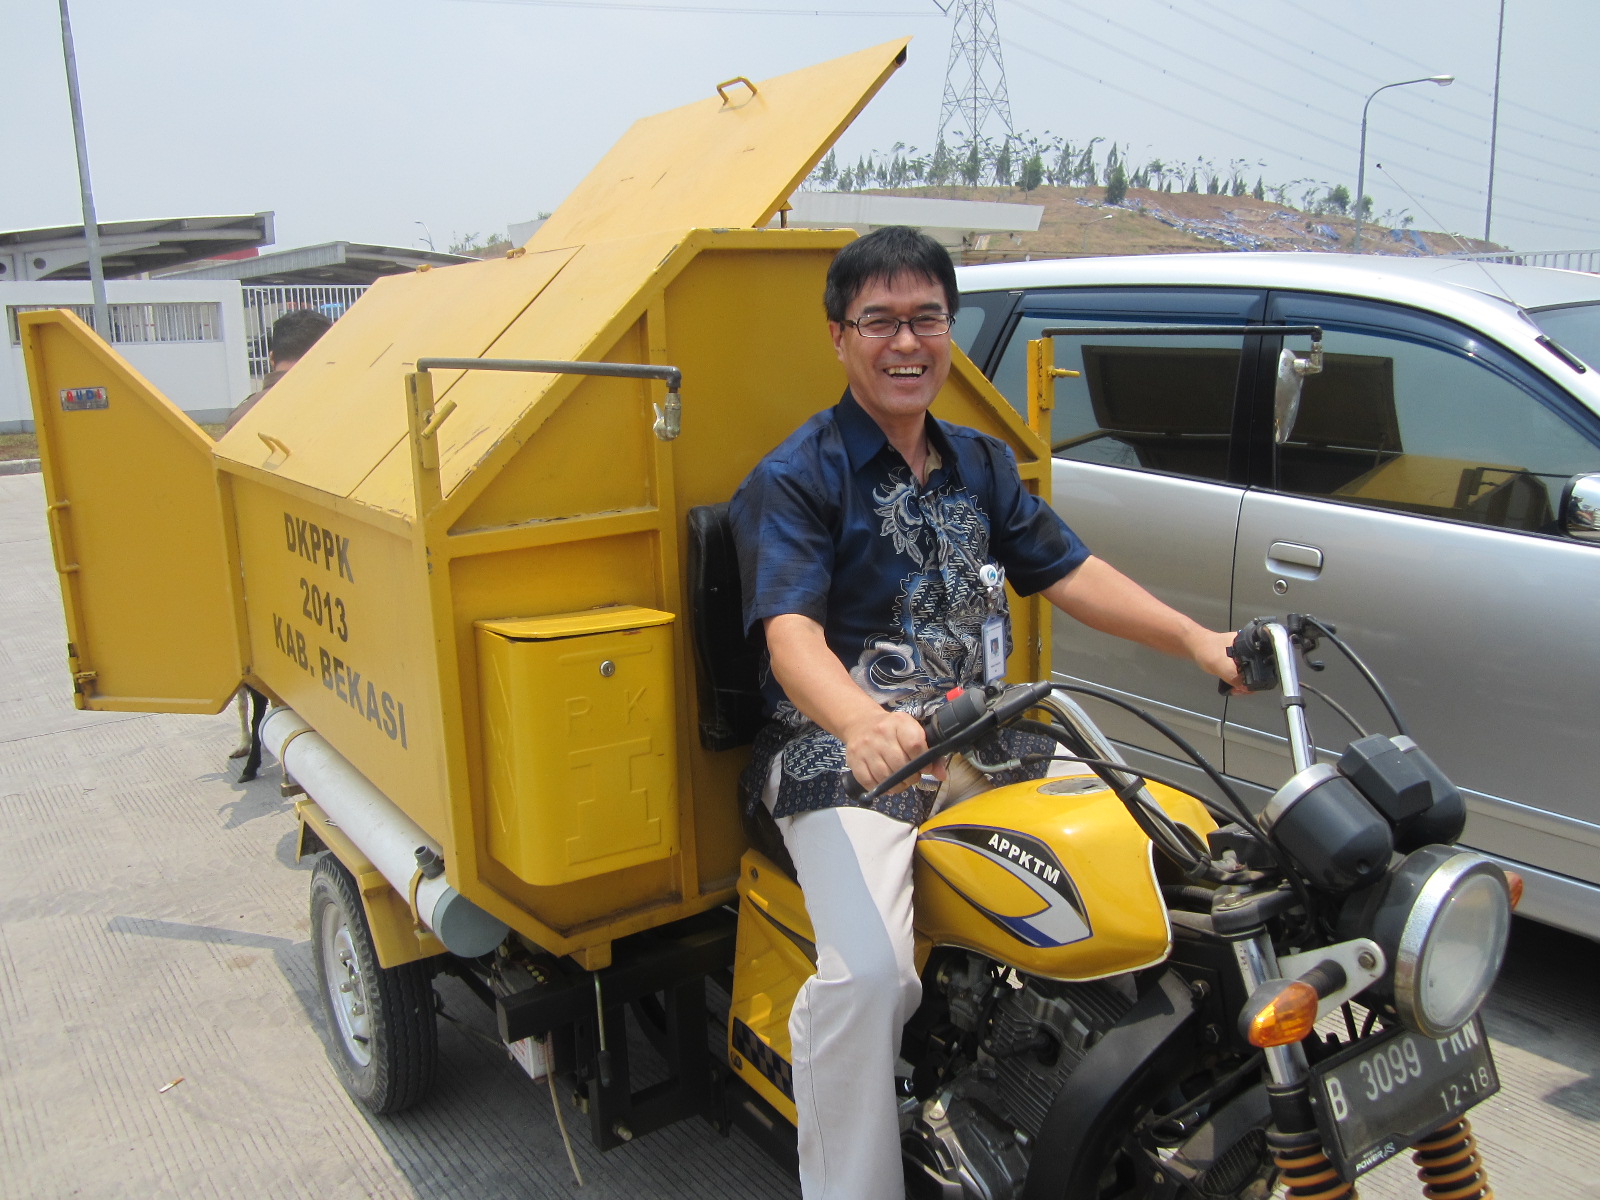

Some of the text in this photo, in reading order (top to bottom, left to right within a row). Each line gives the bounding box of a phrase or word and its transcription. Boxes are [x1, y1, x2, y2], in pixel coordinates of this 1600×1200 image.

[283, 512, 354, 584] DKPPK
[299, 577, 349, 643] 2013
[272, 612, 408, 751] KAB. BEKASI
[987, 833, 1061, 885] APPKTM
[1325, 1077, 1348, 1122] B
[1359, 1037, 1422, 1101] 3099
